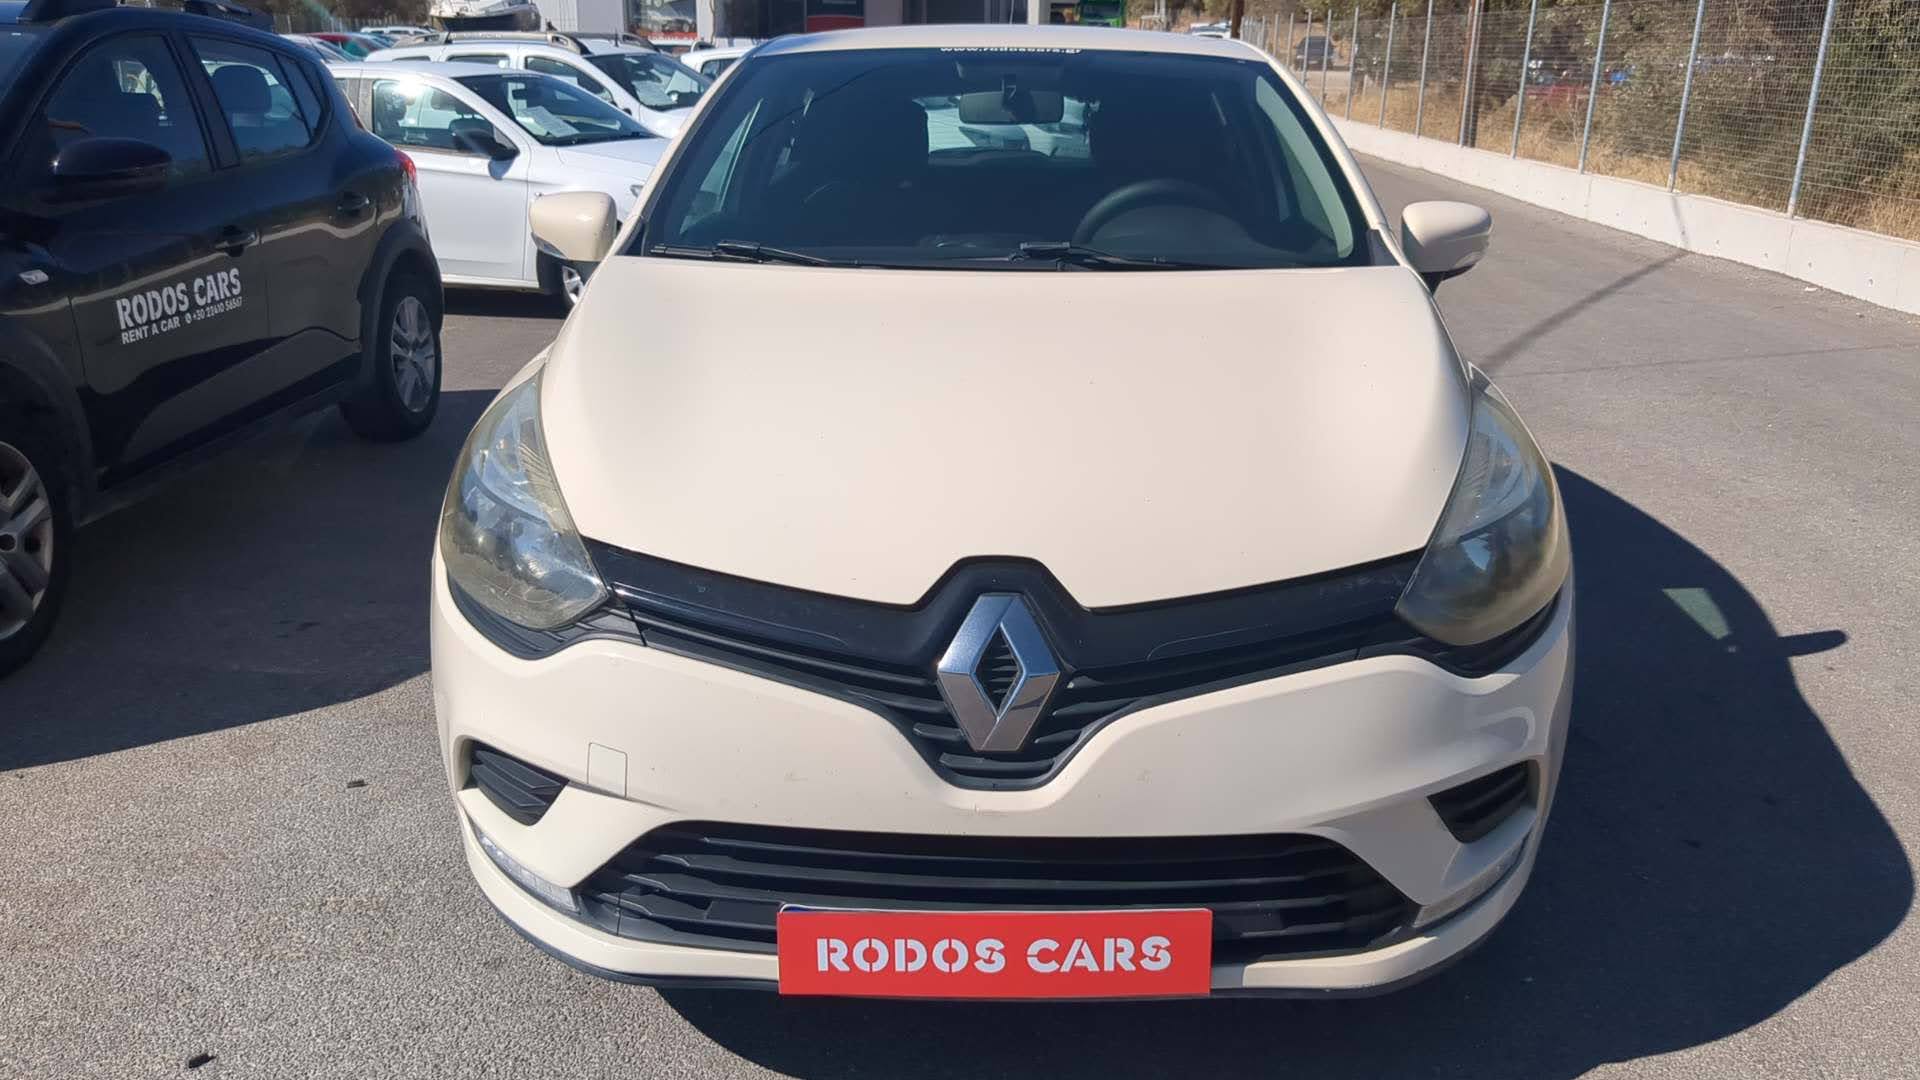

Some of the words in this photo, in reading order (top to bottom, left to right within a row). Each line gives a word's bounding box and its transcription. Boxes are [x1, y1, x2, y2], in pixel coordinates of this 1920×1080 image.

[116, 282, 190, 330] RODOS
[193, 267, 242, 306] CARS
[121, 325, 149, 344] RENT
[151, 322, 160, 336] A
[160, 316, 181, 332] CAR
[816, 938, 1007, 973] RODOS
[1026, 936, 1172, 973] CARS
